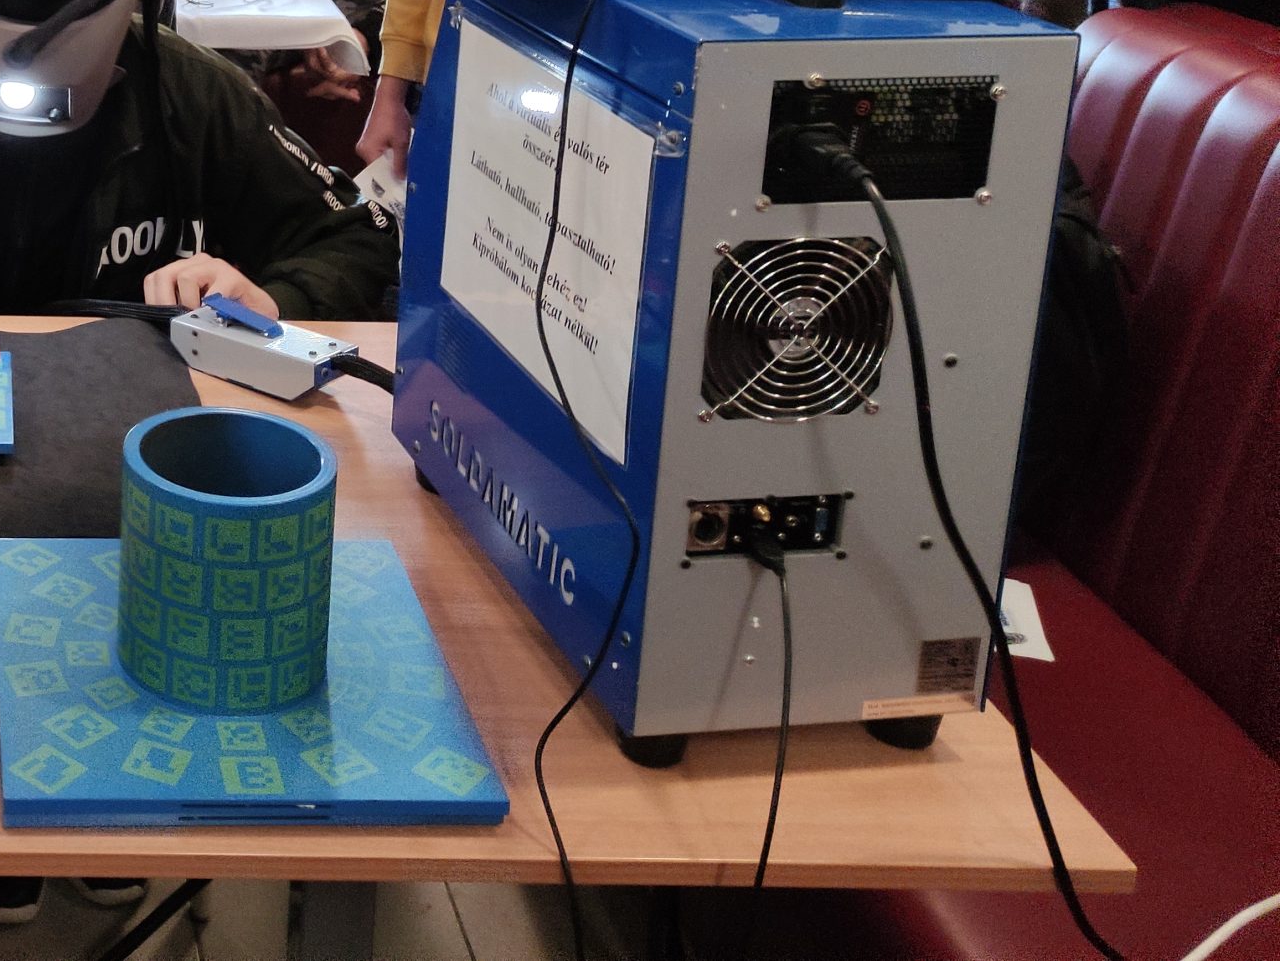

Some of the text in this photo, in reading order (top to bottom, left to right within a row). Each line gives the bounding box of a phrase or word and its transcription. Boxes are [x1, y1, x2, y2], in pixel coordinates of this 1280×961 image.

[470, 150, 503, 190] Látható,
[504, 177, 542, 222] hallható,
[567, 138, 593, 164] valós
[595, 155, 610, 175] tér
[472, 232, 599, 355] Kipróbálom kocázat nélkül!
[486, 216, 588, 313] Nem is olyan ehéz ez!
[429, 399, 577, 607] SOLDAMATIC
